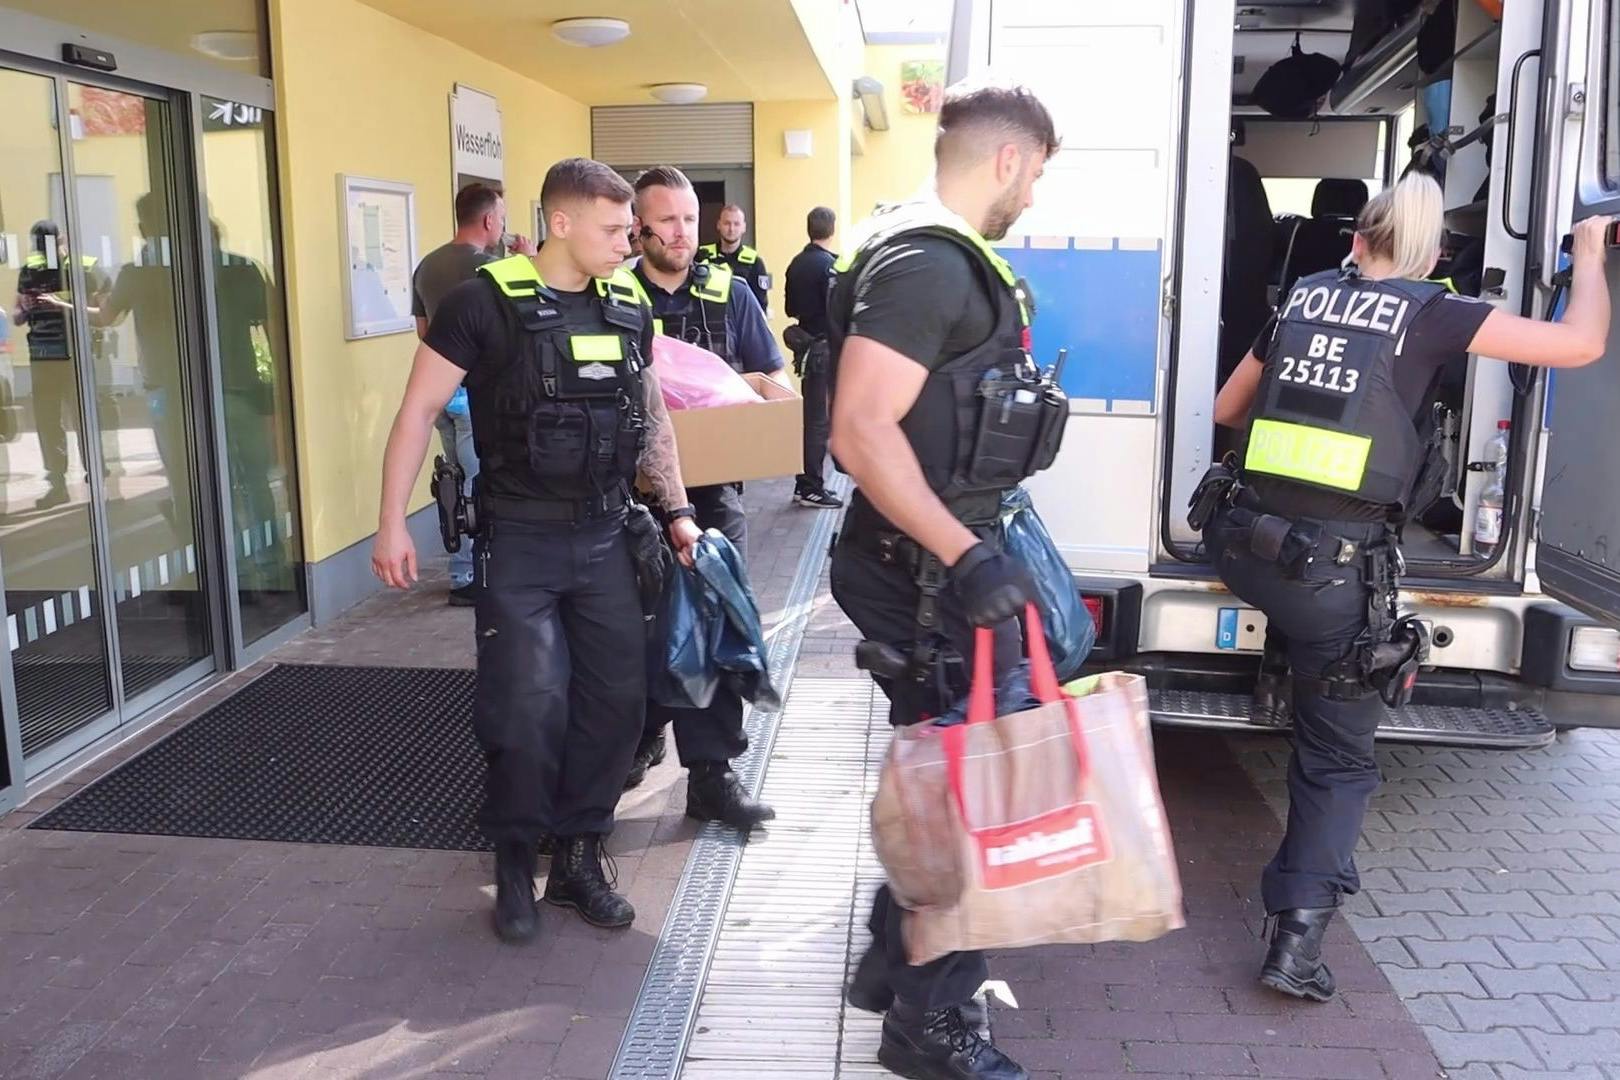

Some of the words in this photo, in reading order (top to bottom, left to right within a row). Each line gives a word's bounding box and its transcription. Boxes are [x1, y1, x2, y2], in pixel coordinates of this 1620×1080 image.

[456, 123, 502, 160] Wasserfloh
[1282, 286, 1409, 335] POLIZEI
[1307, 333, 1348, 362] BE
[1278, 357, 1360, 393] 25113
[1223, 632, 1231, 641] D
